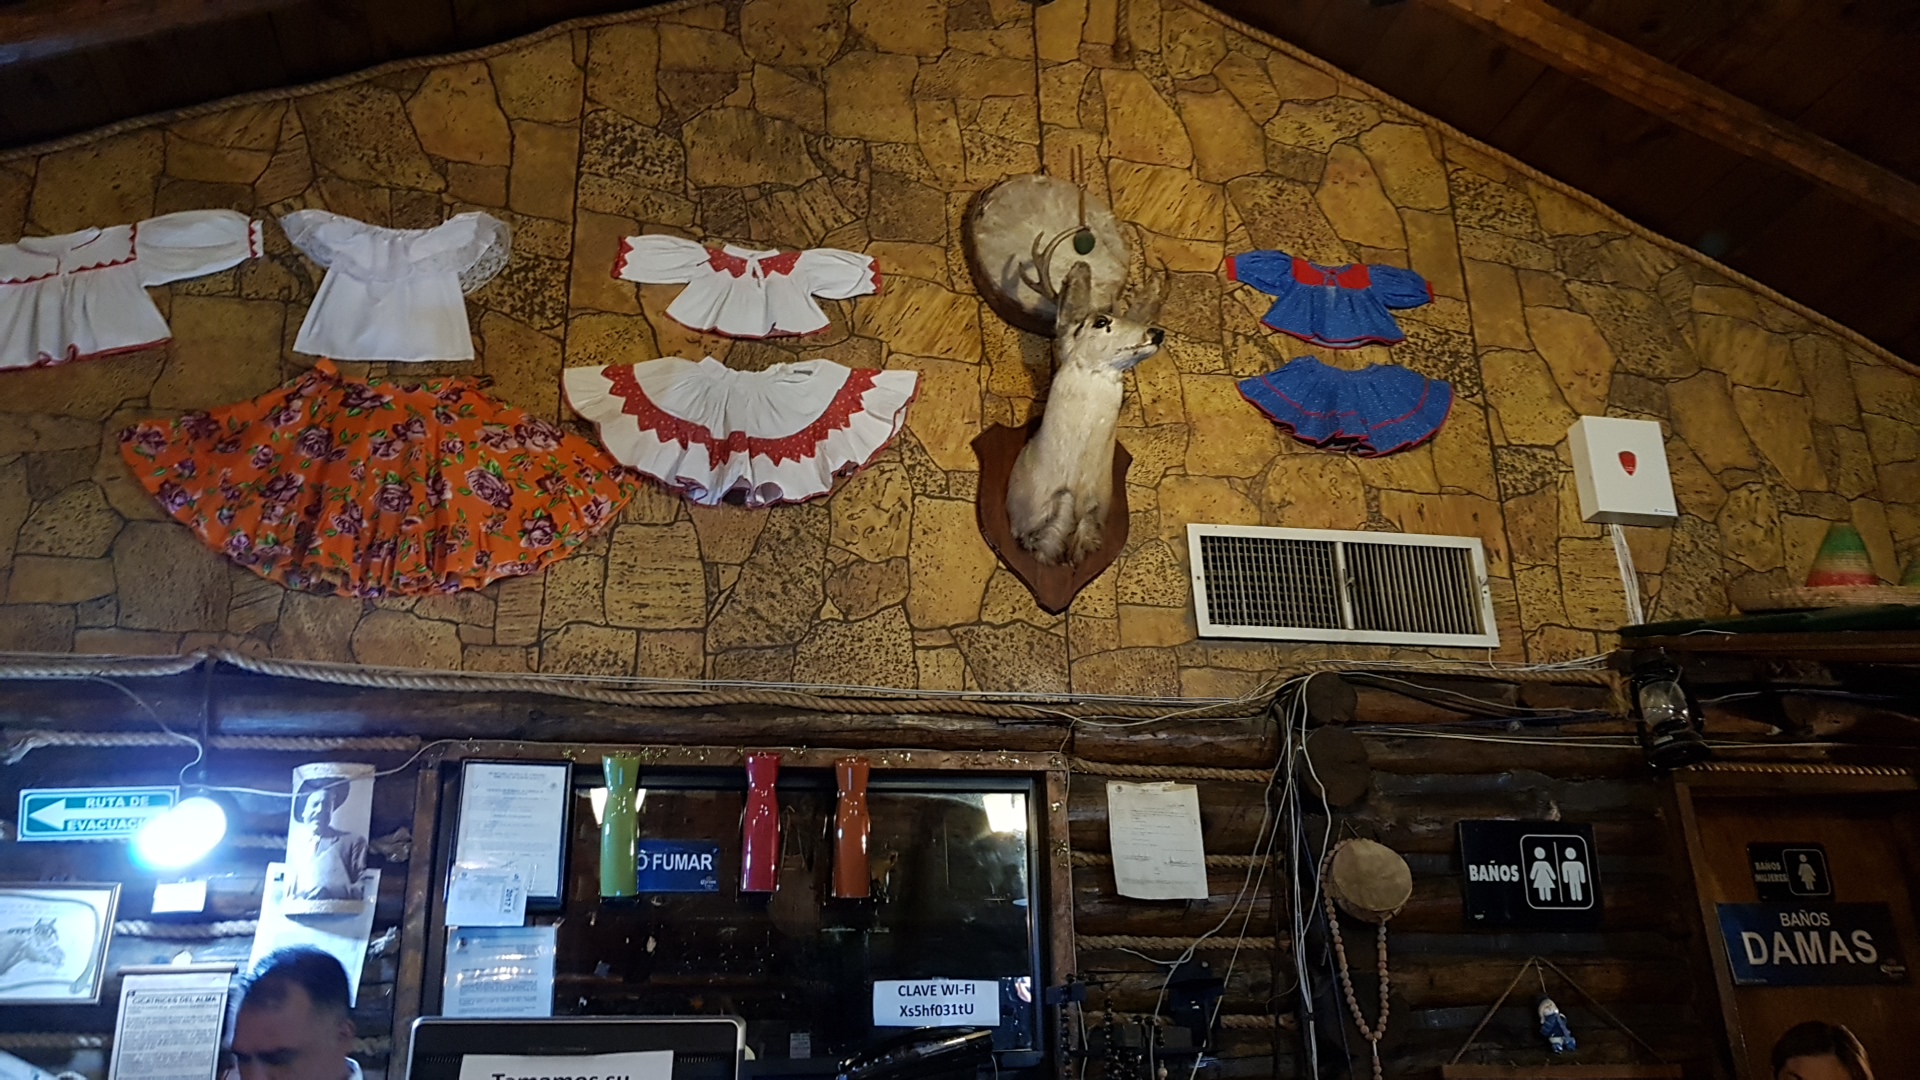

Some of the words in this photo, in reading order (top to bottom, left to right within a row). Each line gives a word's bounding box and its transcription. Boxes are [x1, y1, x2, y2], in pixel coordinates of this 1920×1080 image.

[85, 796, 125, 808] RUTA
[130, 795, 150, 807] DE
[67, 817, 146, 831] EVACUACI
[652, 853, 713, 871] FUMAR
[1468, 860, 1520, 882] BAÑOS
[1779, 909, 1831, 927] BAÑOS
[1741, 929, 1878, 965] DAMAS
[897, 984, 938, 997] CLAVE
[941, 983, 976, 996] WI-FI
[899, 1003, 975, 1017] Xs5hf031tU
